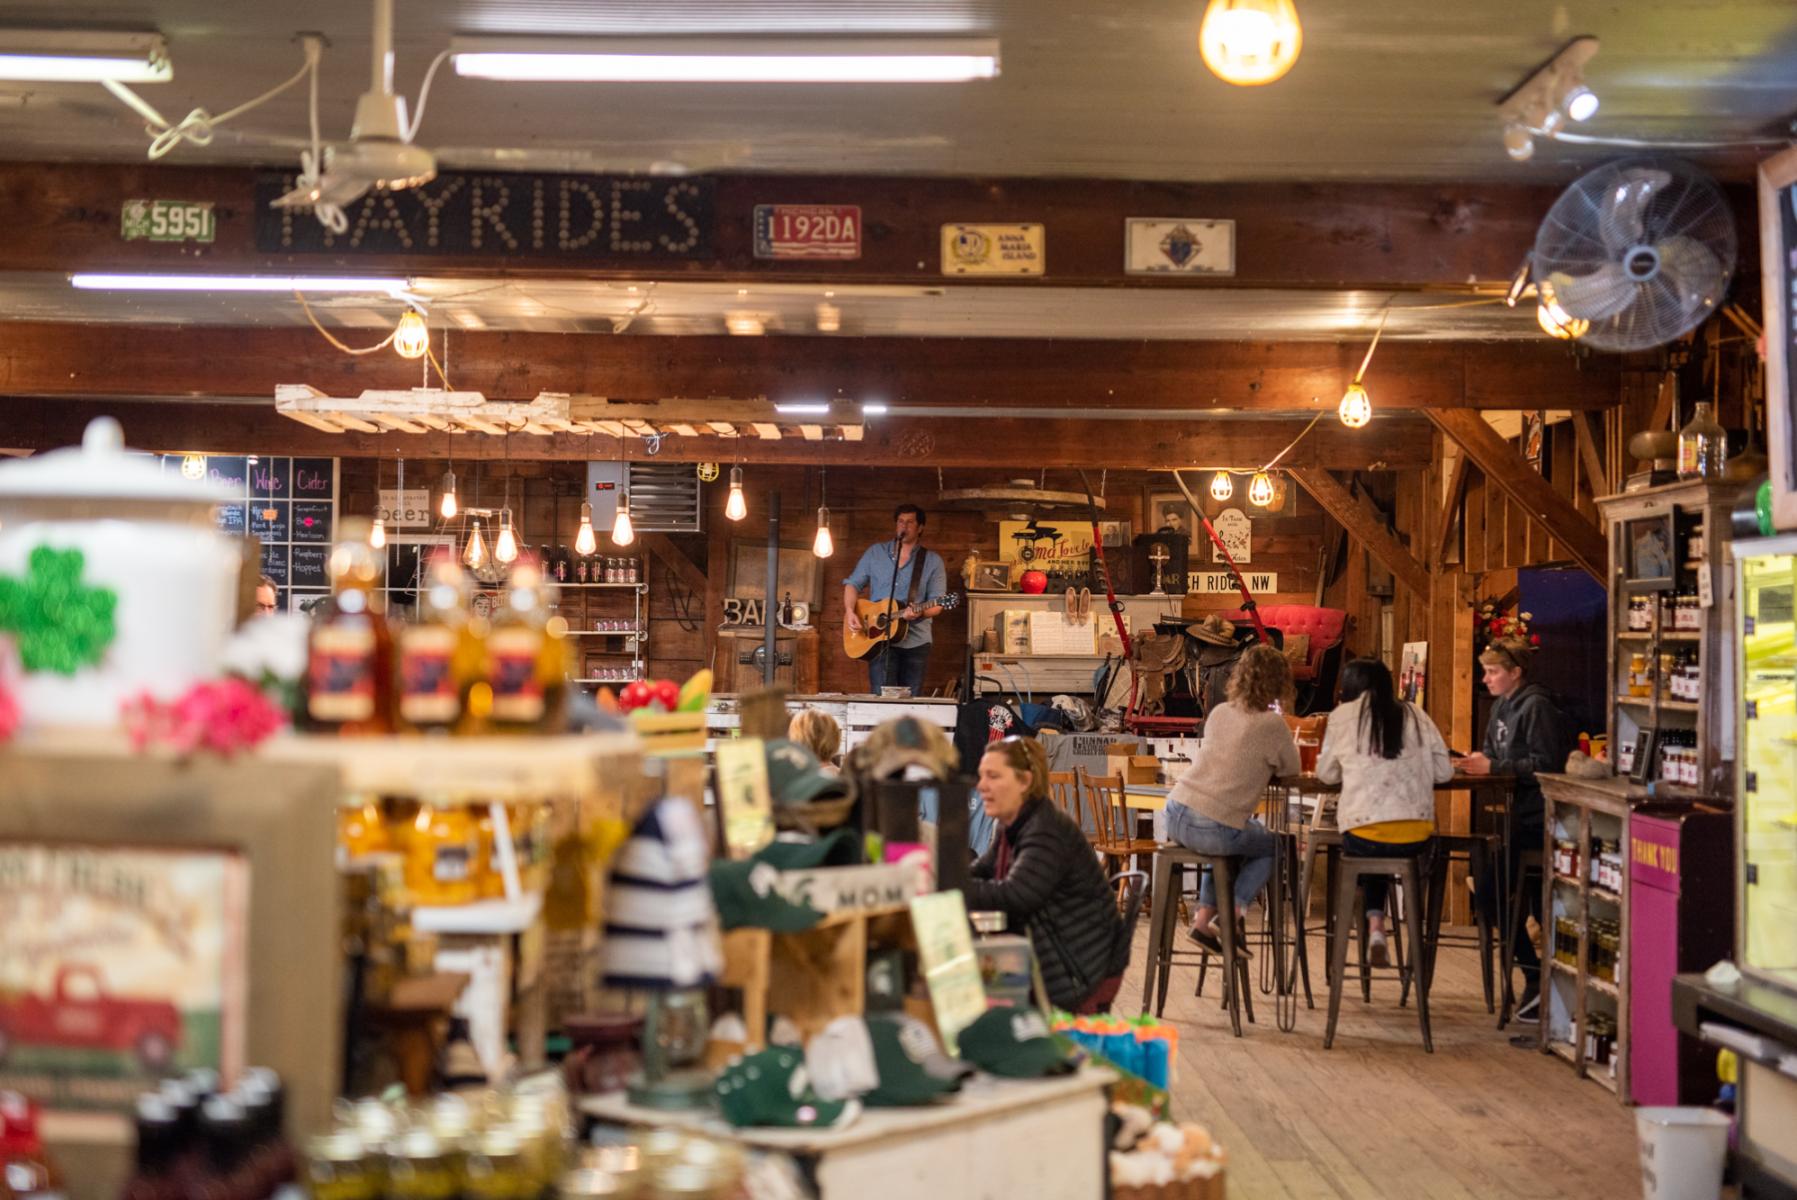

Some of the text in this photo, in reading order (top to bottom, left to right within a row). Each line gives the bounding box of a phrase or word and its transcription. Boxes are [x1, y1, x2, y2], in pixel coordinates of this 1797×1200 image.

[151, 207, 209, 235] 5951
[280, 174, 700, 252] HAYRIDES
[297, 470, 329, 490] Cider
[1187, 575, 1270, 590] H RIDG NW
[1631, 837, 1678, 874] THANK YOU
[838, 886, 903, 906] MOM
